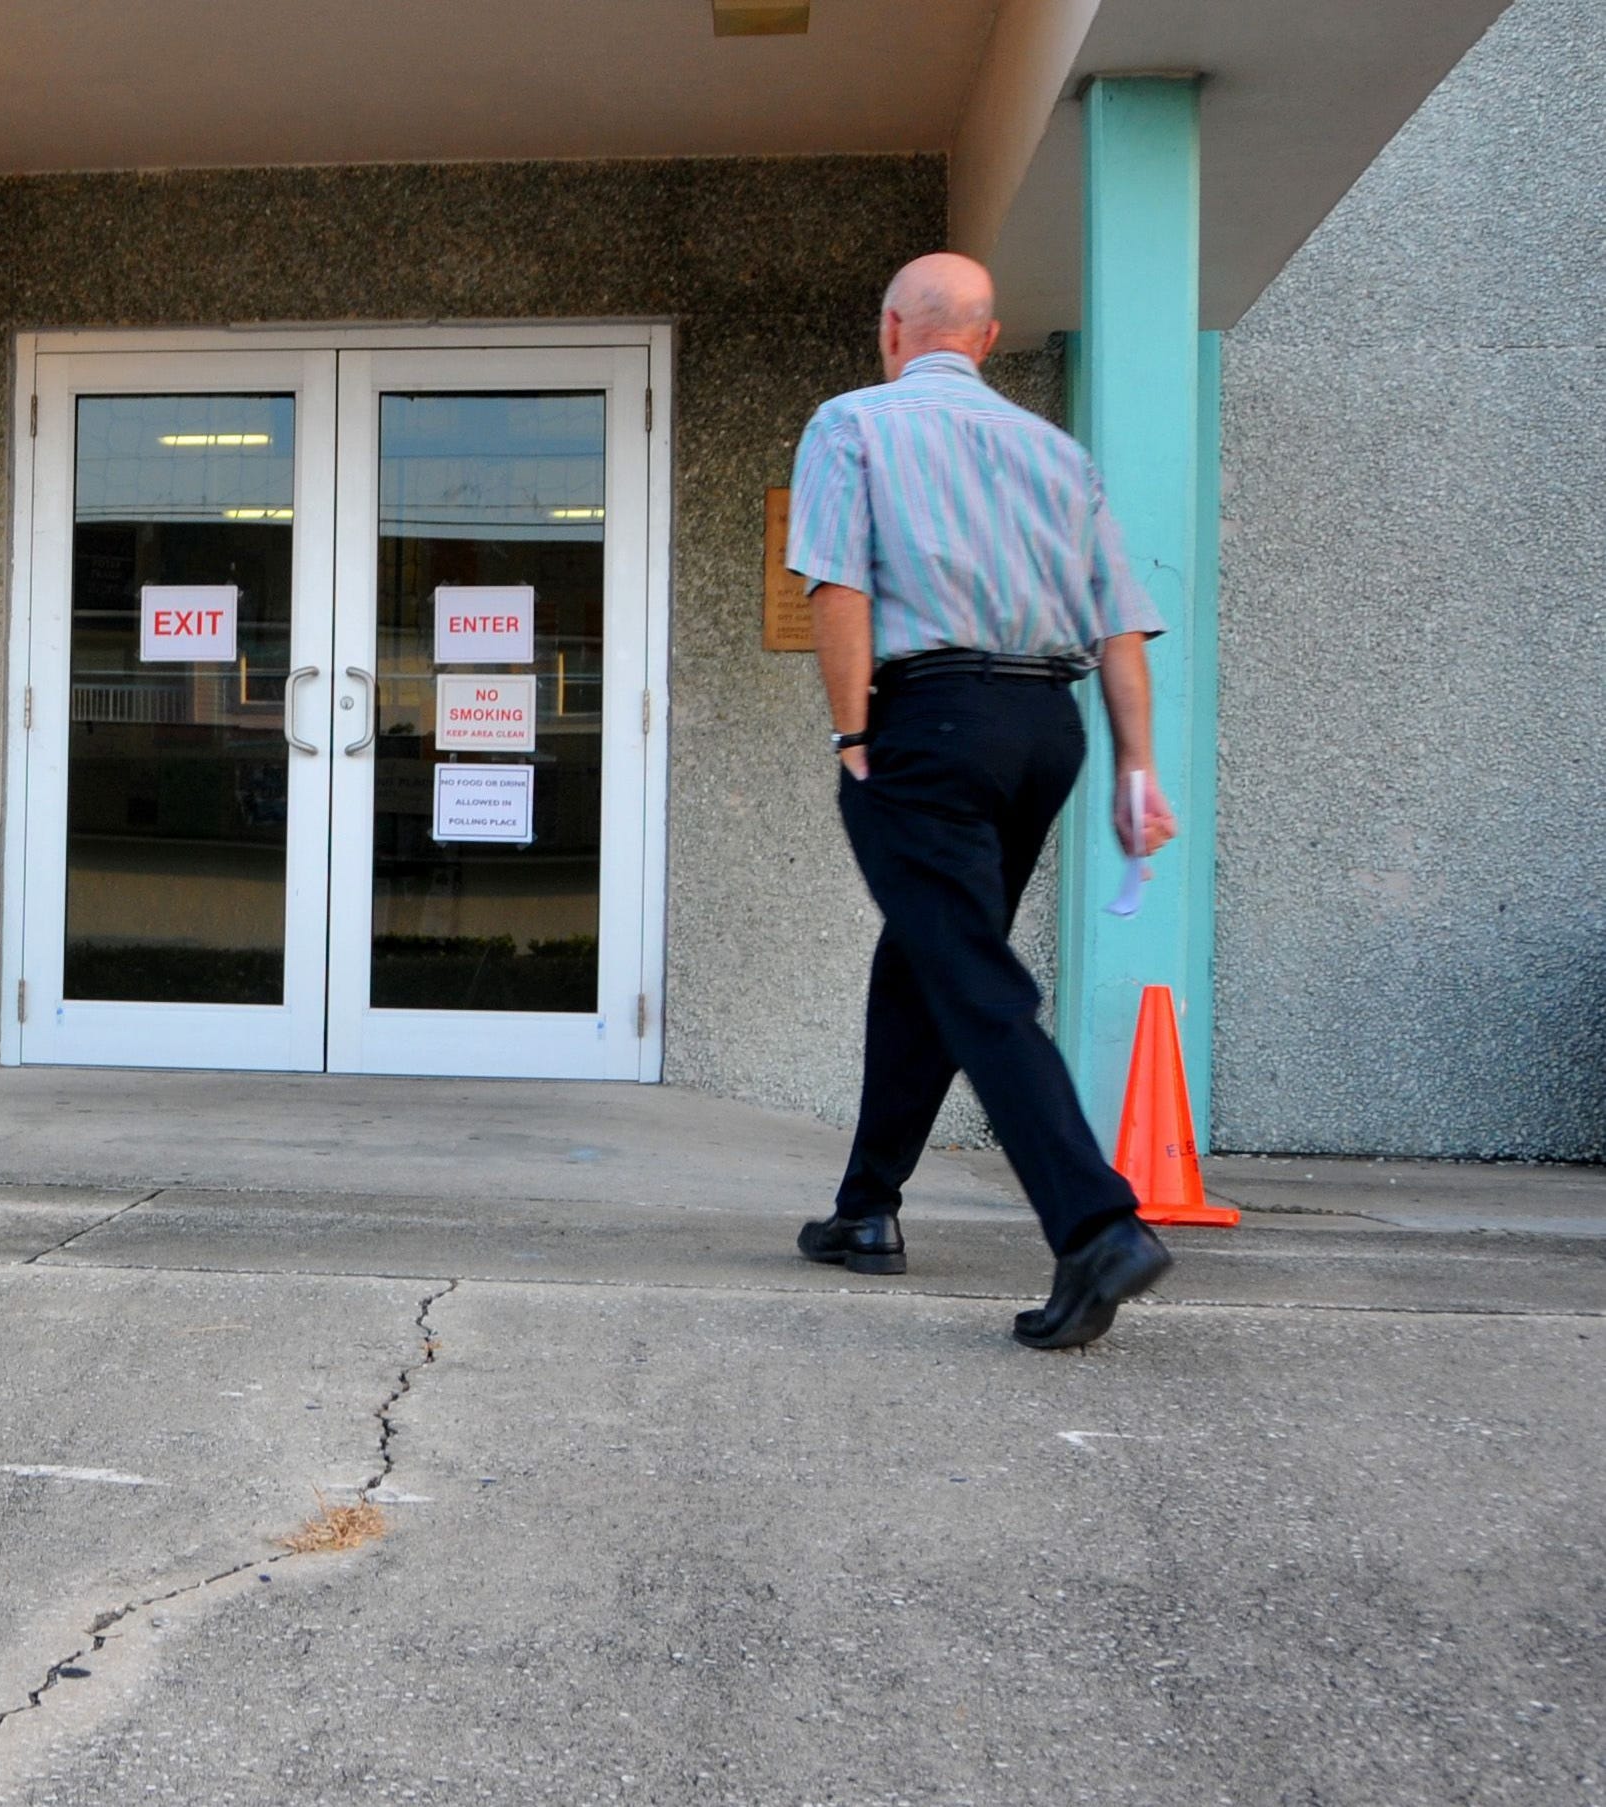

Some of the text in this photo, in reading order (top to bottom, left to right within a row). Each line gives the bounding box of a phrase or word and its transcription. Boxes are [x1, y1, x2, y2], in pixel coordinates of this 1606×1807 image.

[154, 610, 224, 636] EXIT
[448, 616, 520, 633] ENTER
[475, 688, 498, 701] NO
[449, 708, 523, 721] SMOKING
[446, 729, 525, 738] KEEP AREA CLEAN
[457, 779, 483, 787] FOOD
[500, 780, 526, 788] DRINK
[455, 799, 512, 807] ALLOWED IN
[449, 817, 517, 827] POLLING PLACE
